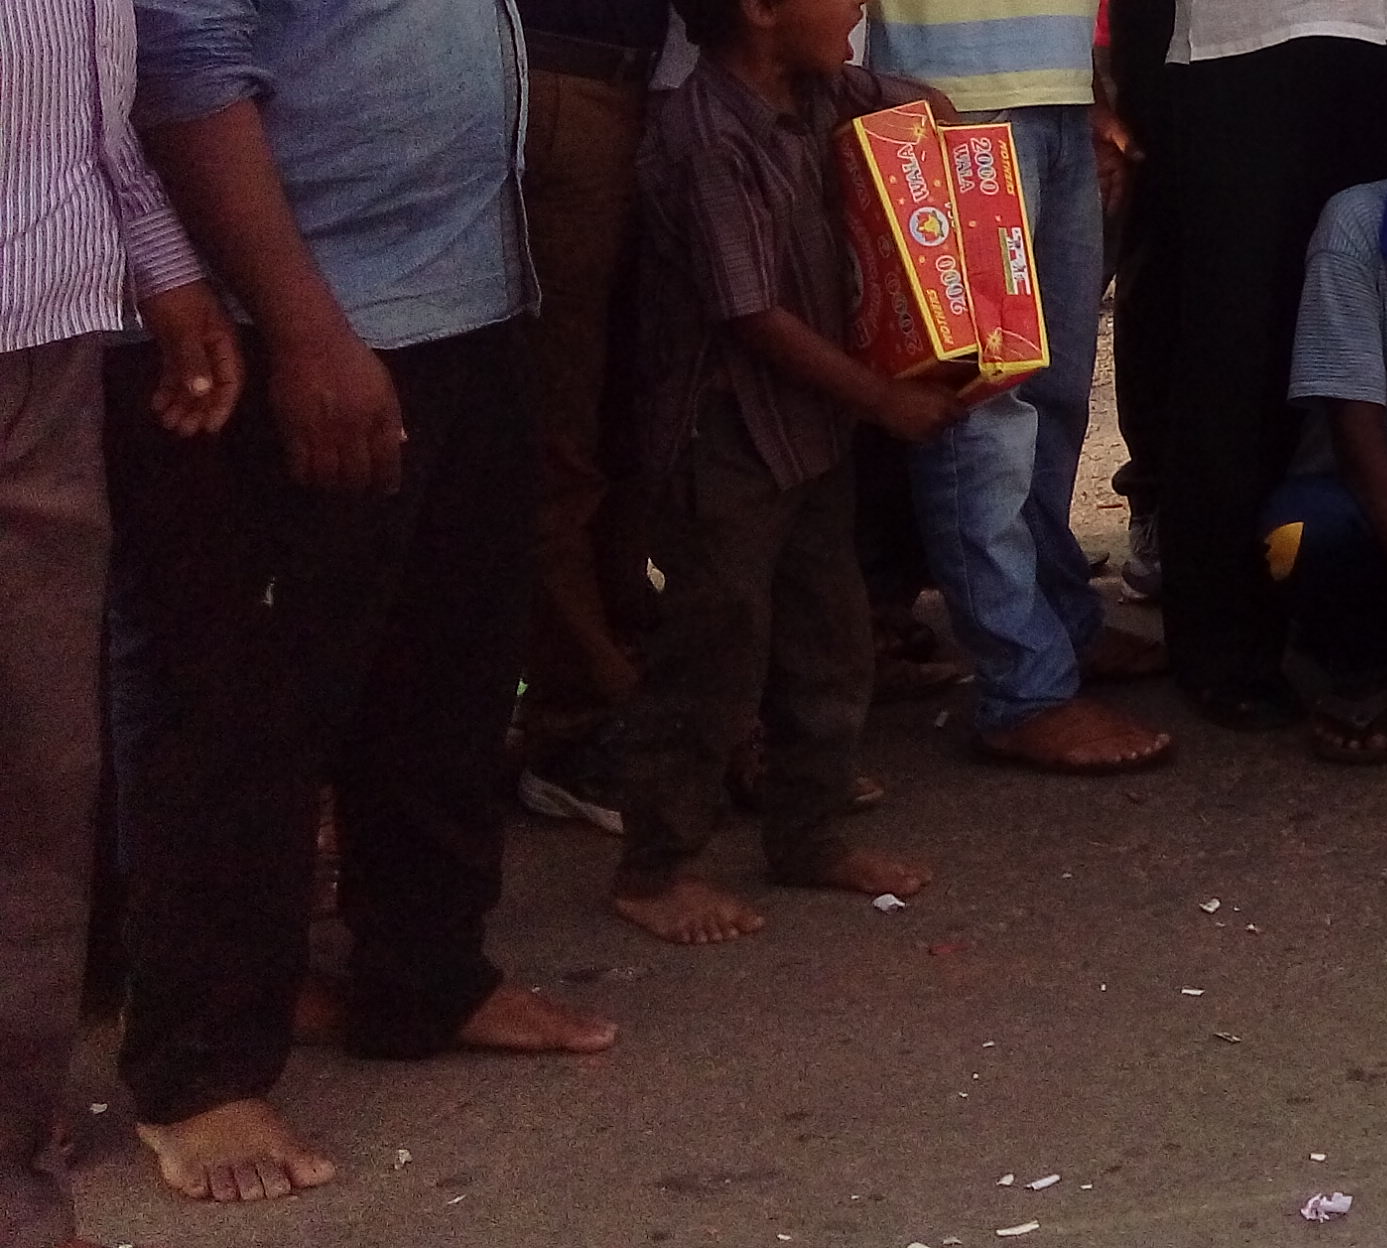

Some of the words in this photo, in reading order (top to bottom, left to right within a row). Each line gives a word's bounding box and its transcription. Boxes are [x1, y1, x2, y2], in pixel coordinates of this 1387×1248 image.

[897, 142, 930, 202] WALA
[953, 143, 975, 193] WALA
[970, 136, 1000, 196] 2000
[935, 255, 967, 315] 2000
